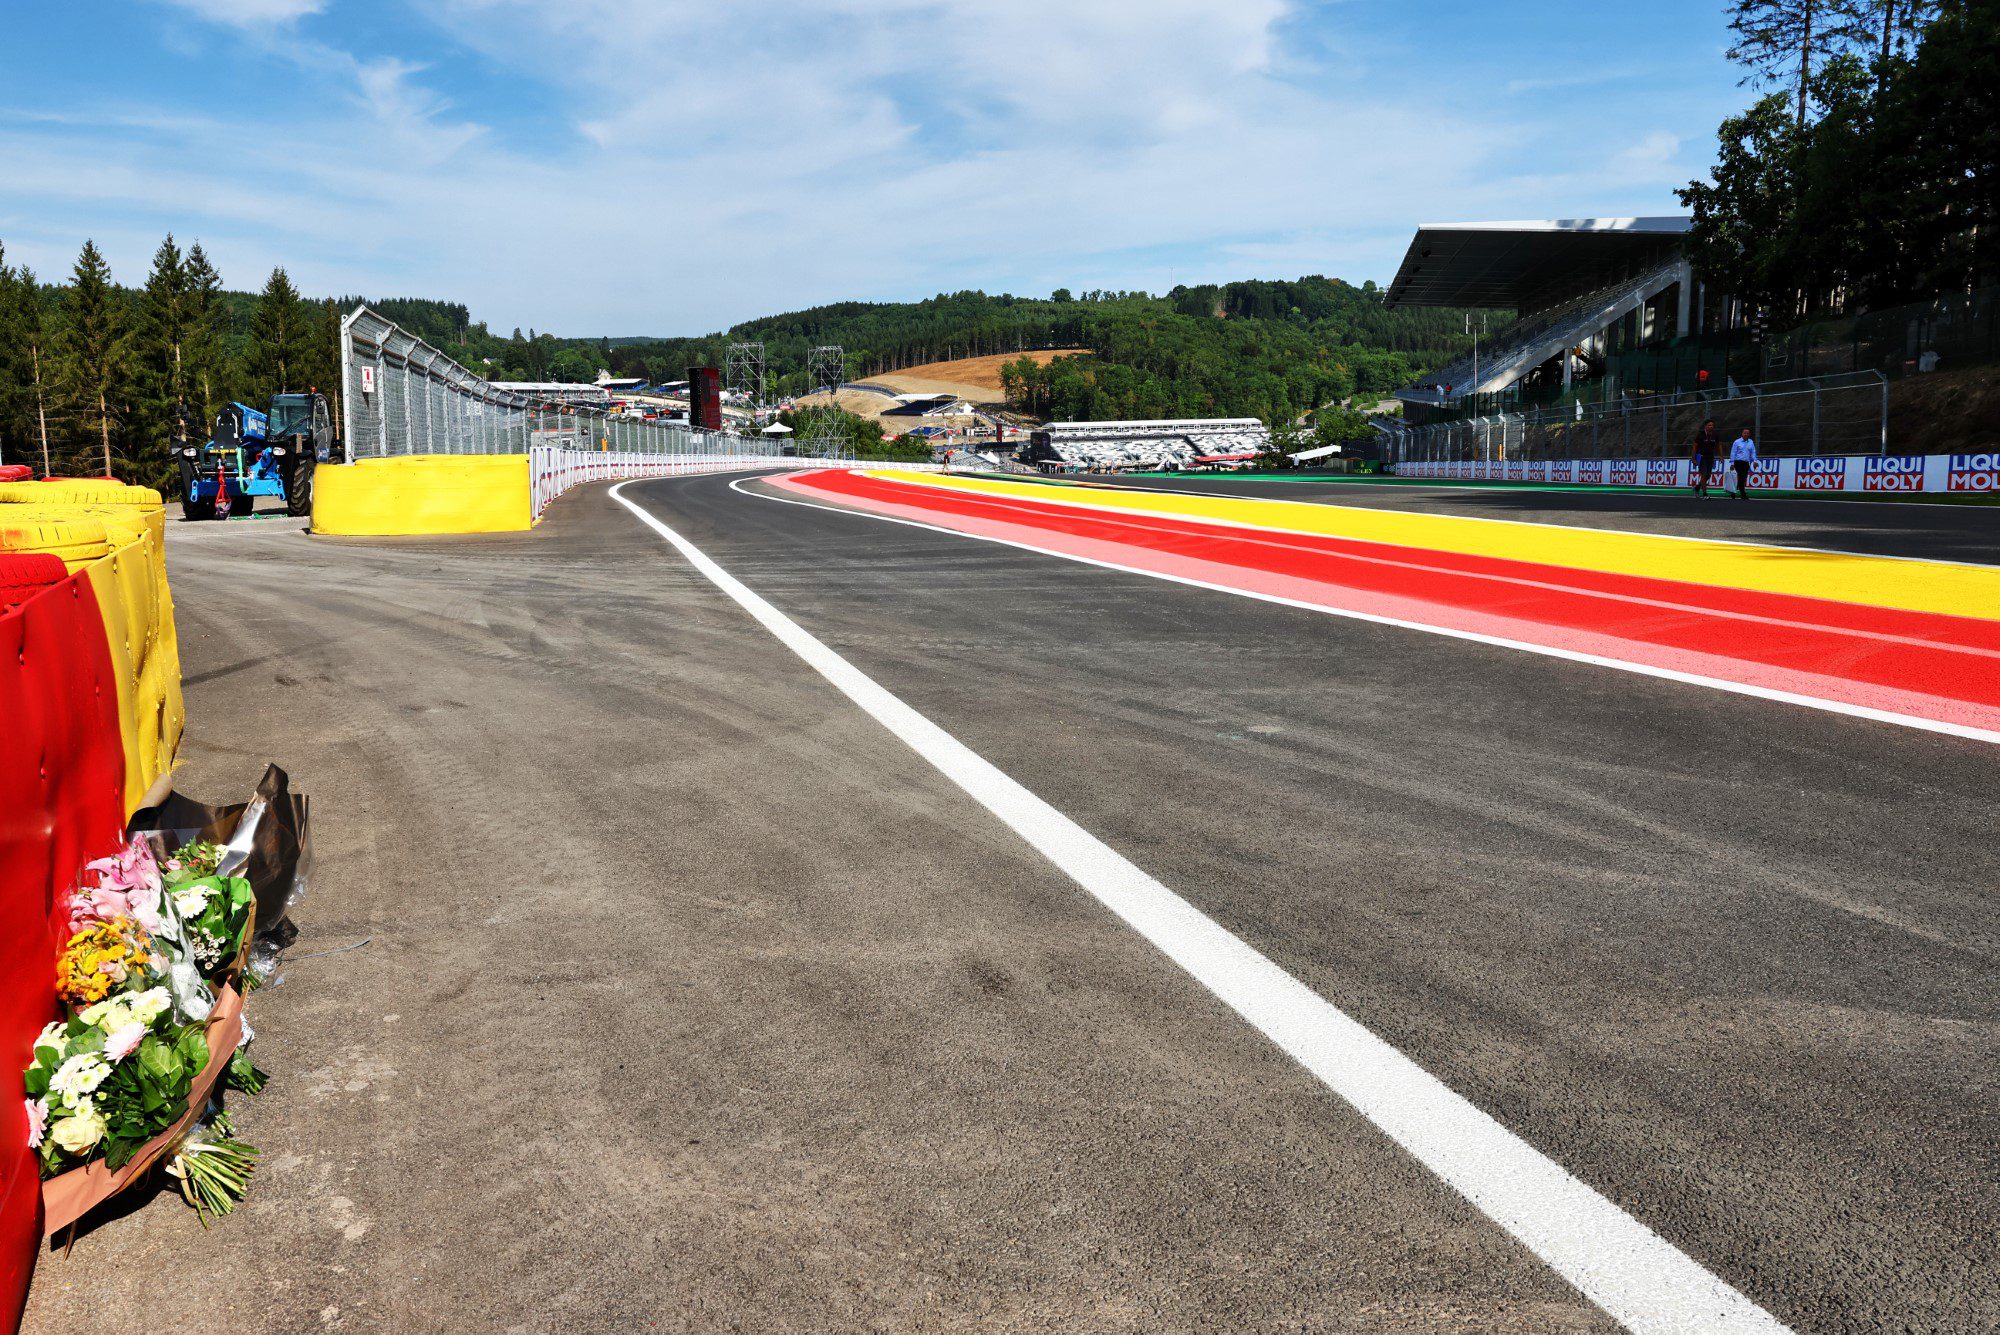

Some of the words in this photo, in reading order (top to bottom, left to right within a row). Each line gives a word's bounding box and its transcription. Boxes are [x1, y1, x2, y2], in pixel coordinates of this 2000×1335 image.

[1529, 461, 1545, 471] LIQUI
[1552, 461, 1571, 471] LIQUI
[1580, 461, 1601, 471] LIQUI
[1611, 461, 1636, 472] LIQUI
[1648, 461, 1676, 472] LIQUI
[1690, 460, 1723, 472] LIUI
[1798, 458, 1844, 474] LIQUI
[1867, 456, 1922, 473] LIQUI
[1529, 471, 1545, 480] MOLY
[1551, 472, 1571, 481] MOLY
[1579, 473, 1601, 483] MOLY
[1611, 473, 1636, 484] MOLY
[1647, 473, 1676, 485] MOLY
[1796, 474, 1843, 489] MOLY
[1866, 474, 1923, 490] MOLY
